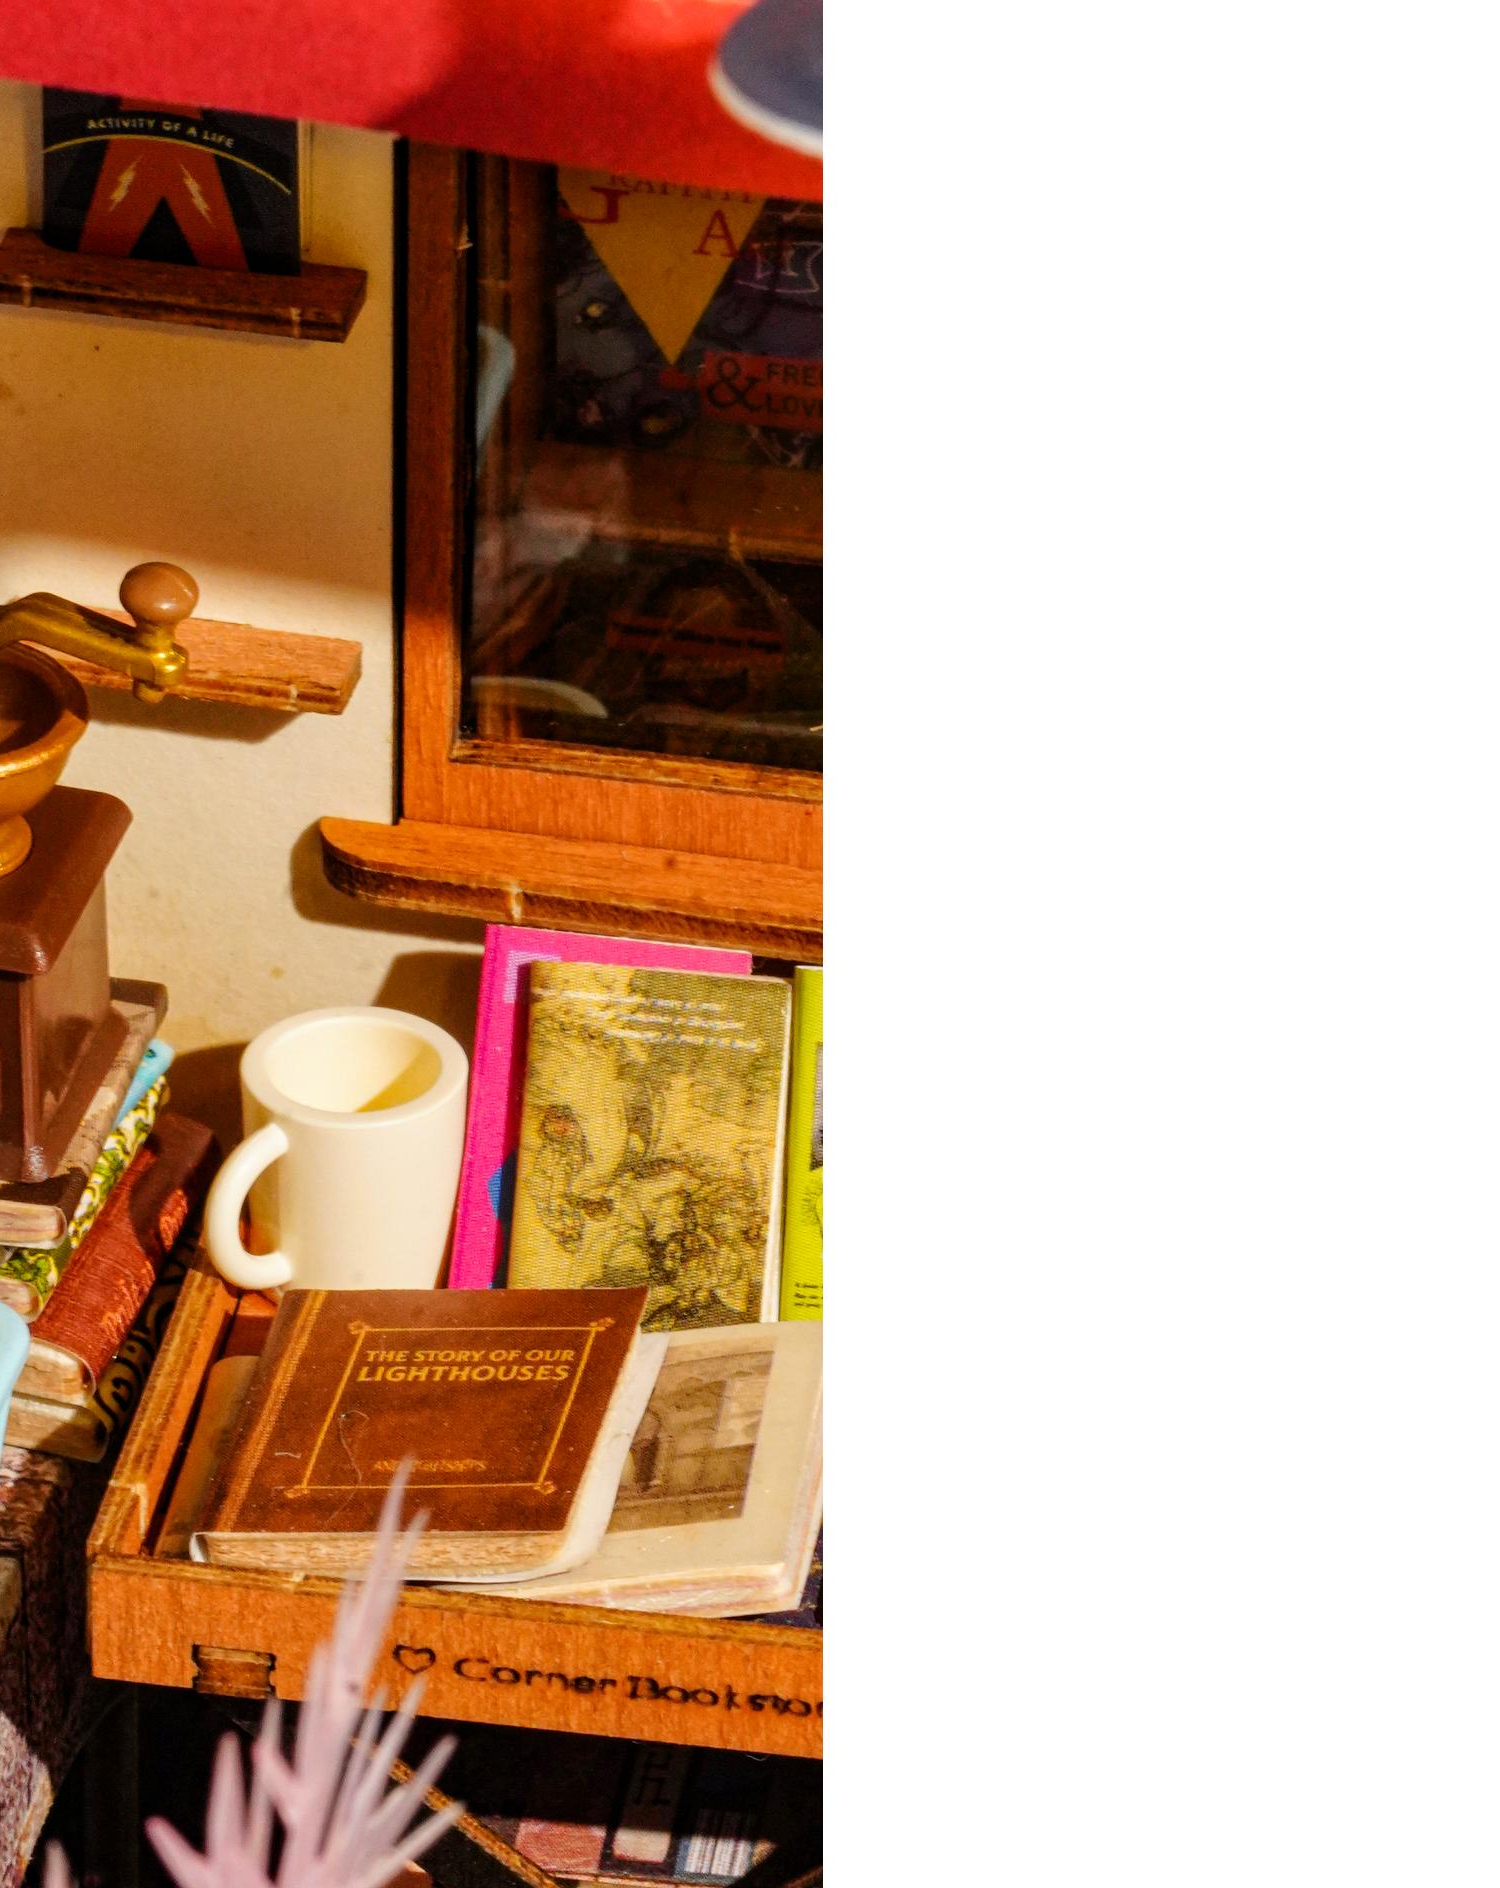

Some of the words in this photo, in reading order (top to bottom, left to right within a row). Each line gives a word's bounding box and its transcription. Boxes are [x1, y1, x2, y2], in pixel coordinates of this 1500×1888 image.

[86, 117, 156, 129] ACTIVITY
[161, 121, 181, 132] OF
[186, 126, 198, 138] A
[202, 130, 235, 148] LIFE
[707, 357, 763, 413] &
[767, 363, 823, 388] FRE
[767, 393, 823, 416] LOV
[365, 1350, 410, 1362] THE
[412, 1350, 486, 1362] STORY
[488, 1350, 522, 1362] OF
[523, 1349, 576, 1361] OUR
[356, 1365, 574, 1383] LIGHTHOUSES
[453, 1657, 618, 1694] Corner
[626, 1675, 823, 1718] Booksto
